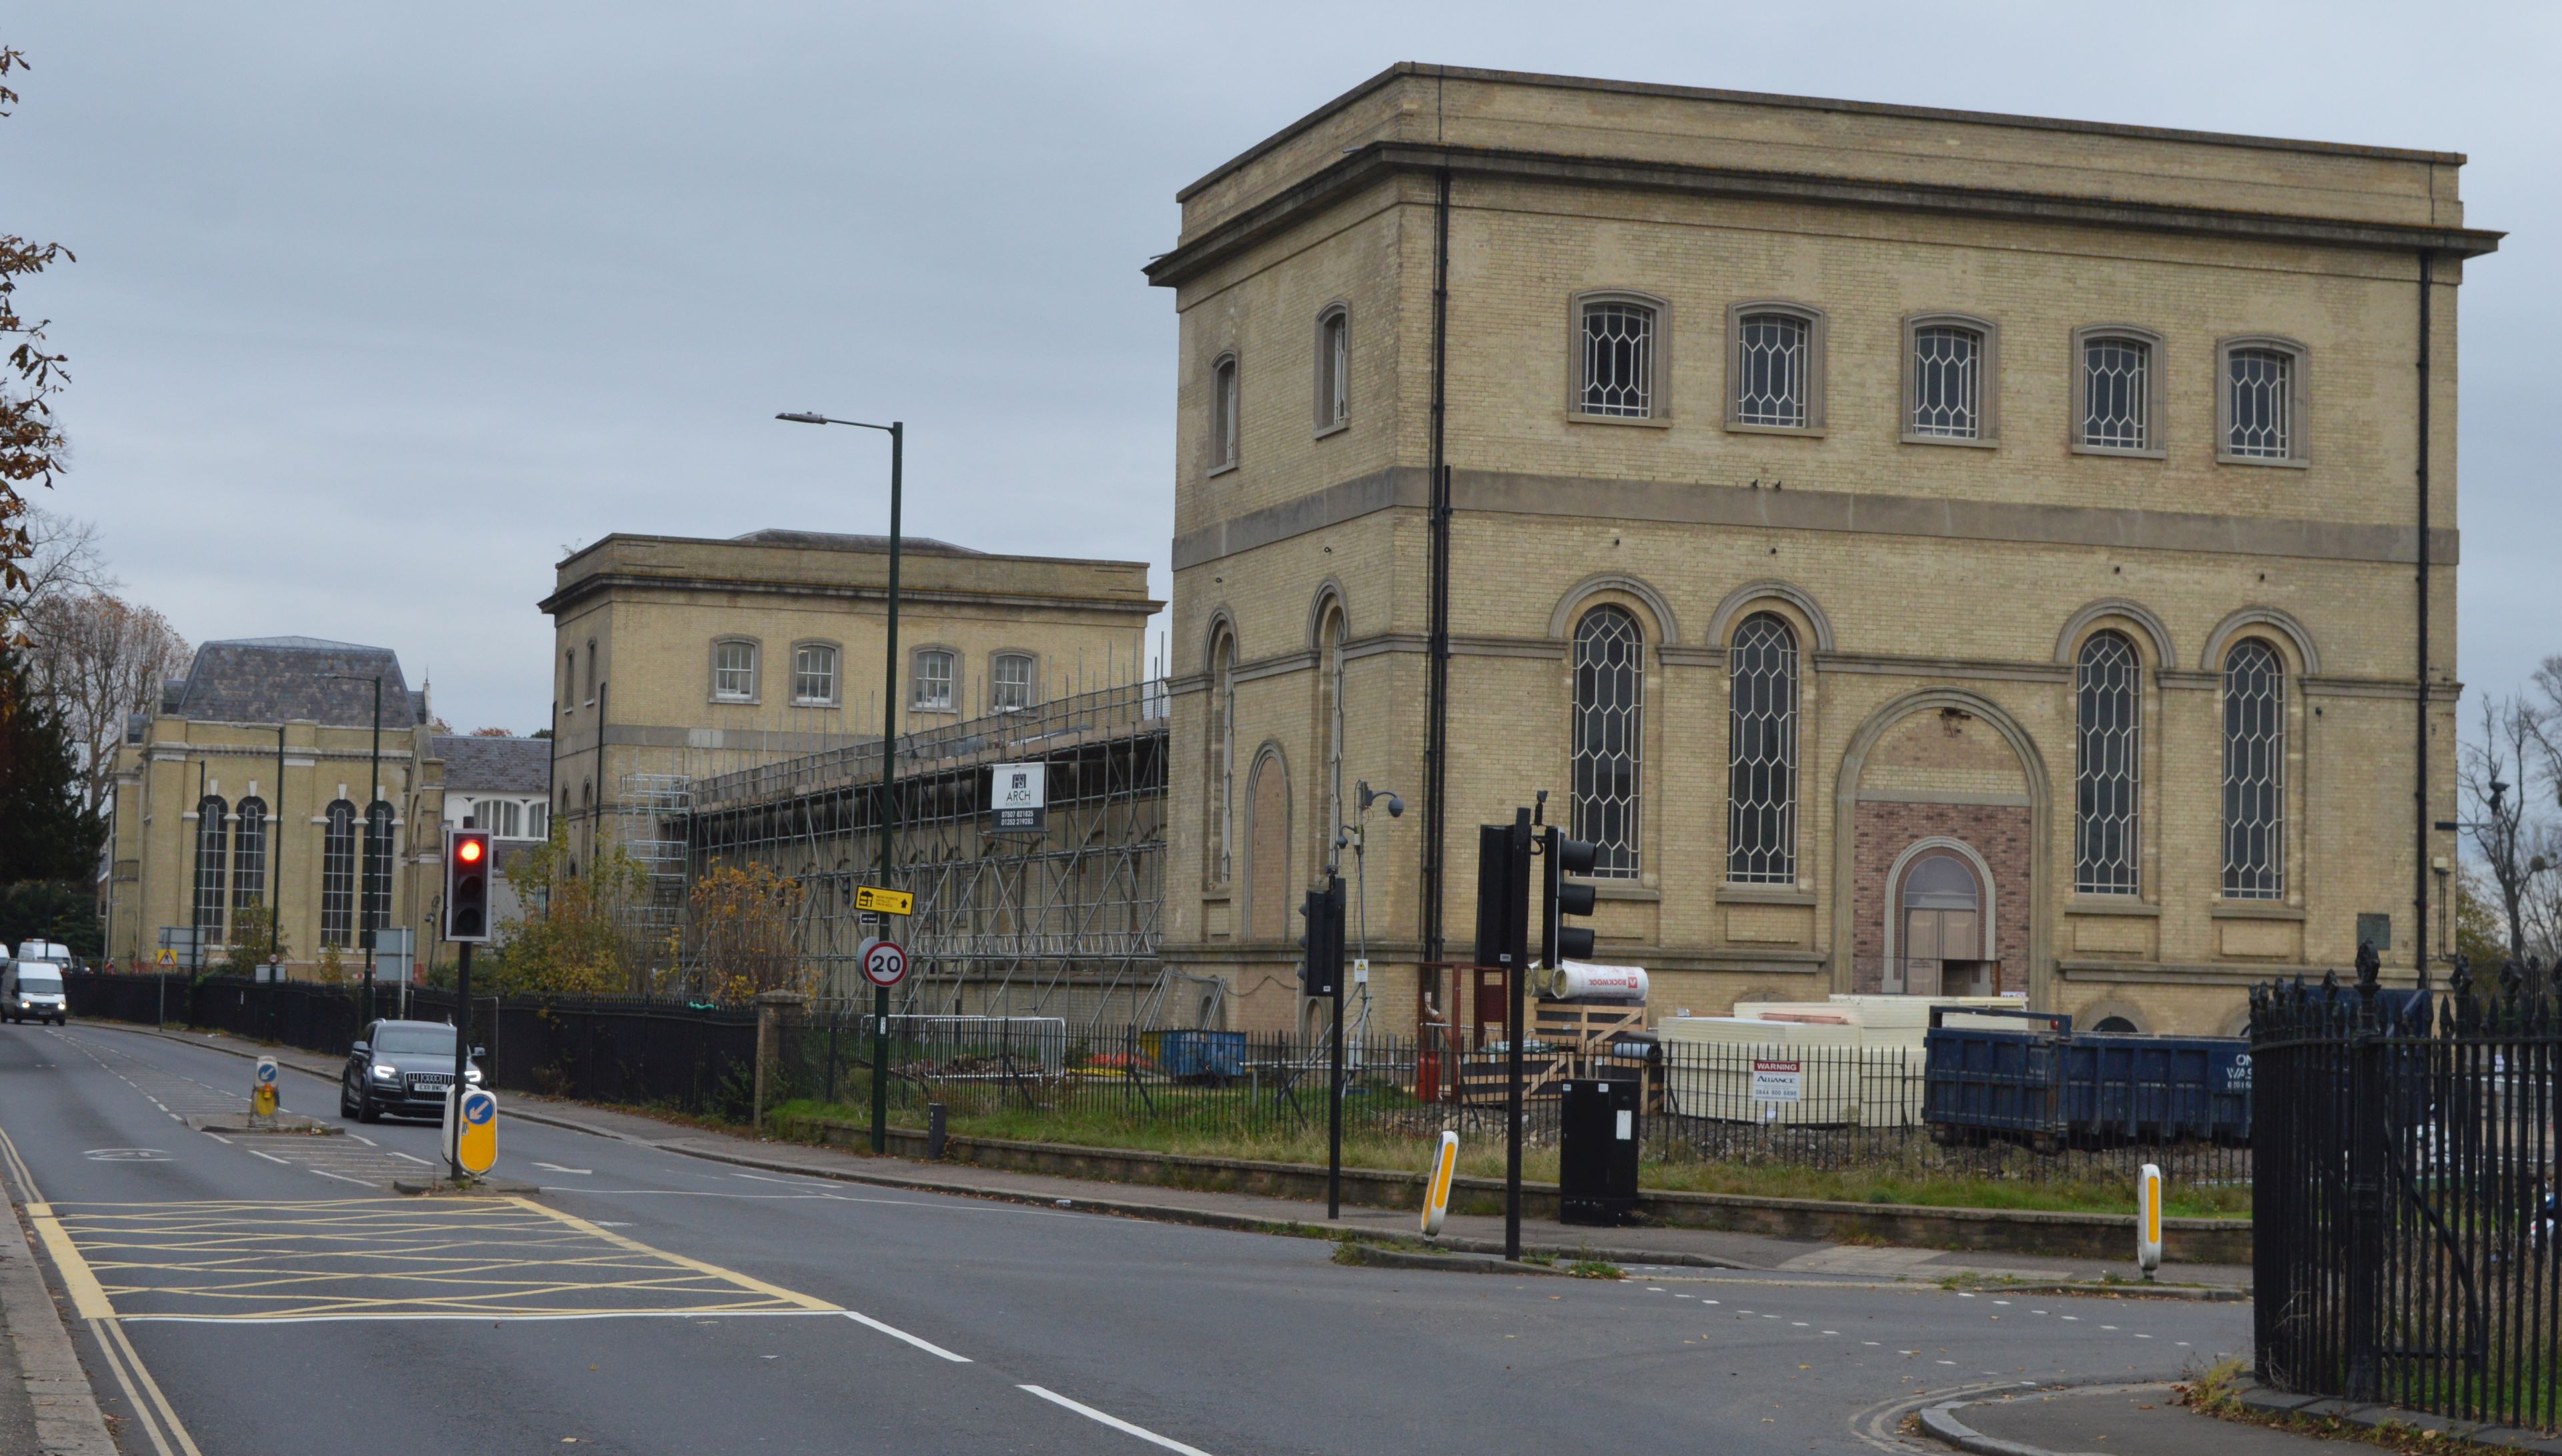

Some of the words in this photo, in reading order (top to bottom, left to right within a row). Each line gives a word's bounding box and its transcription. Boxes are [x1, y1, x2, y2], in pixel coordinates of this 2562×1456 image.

[1006, 790, 1031, 802] ARCH
[872, 955, 901, 972] 20
[1757, 1062, 1797, 1071] WARNING
